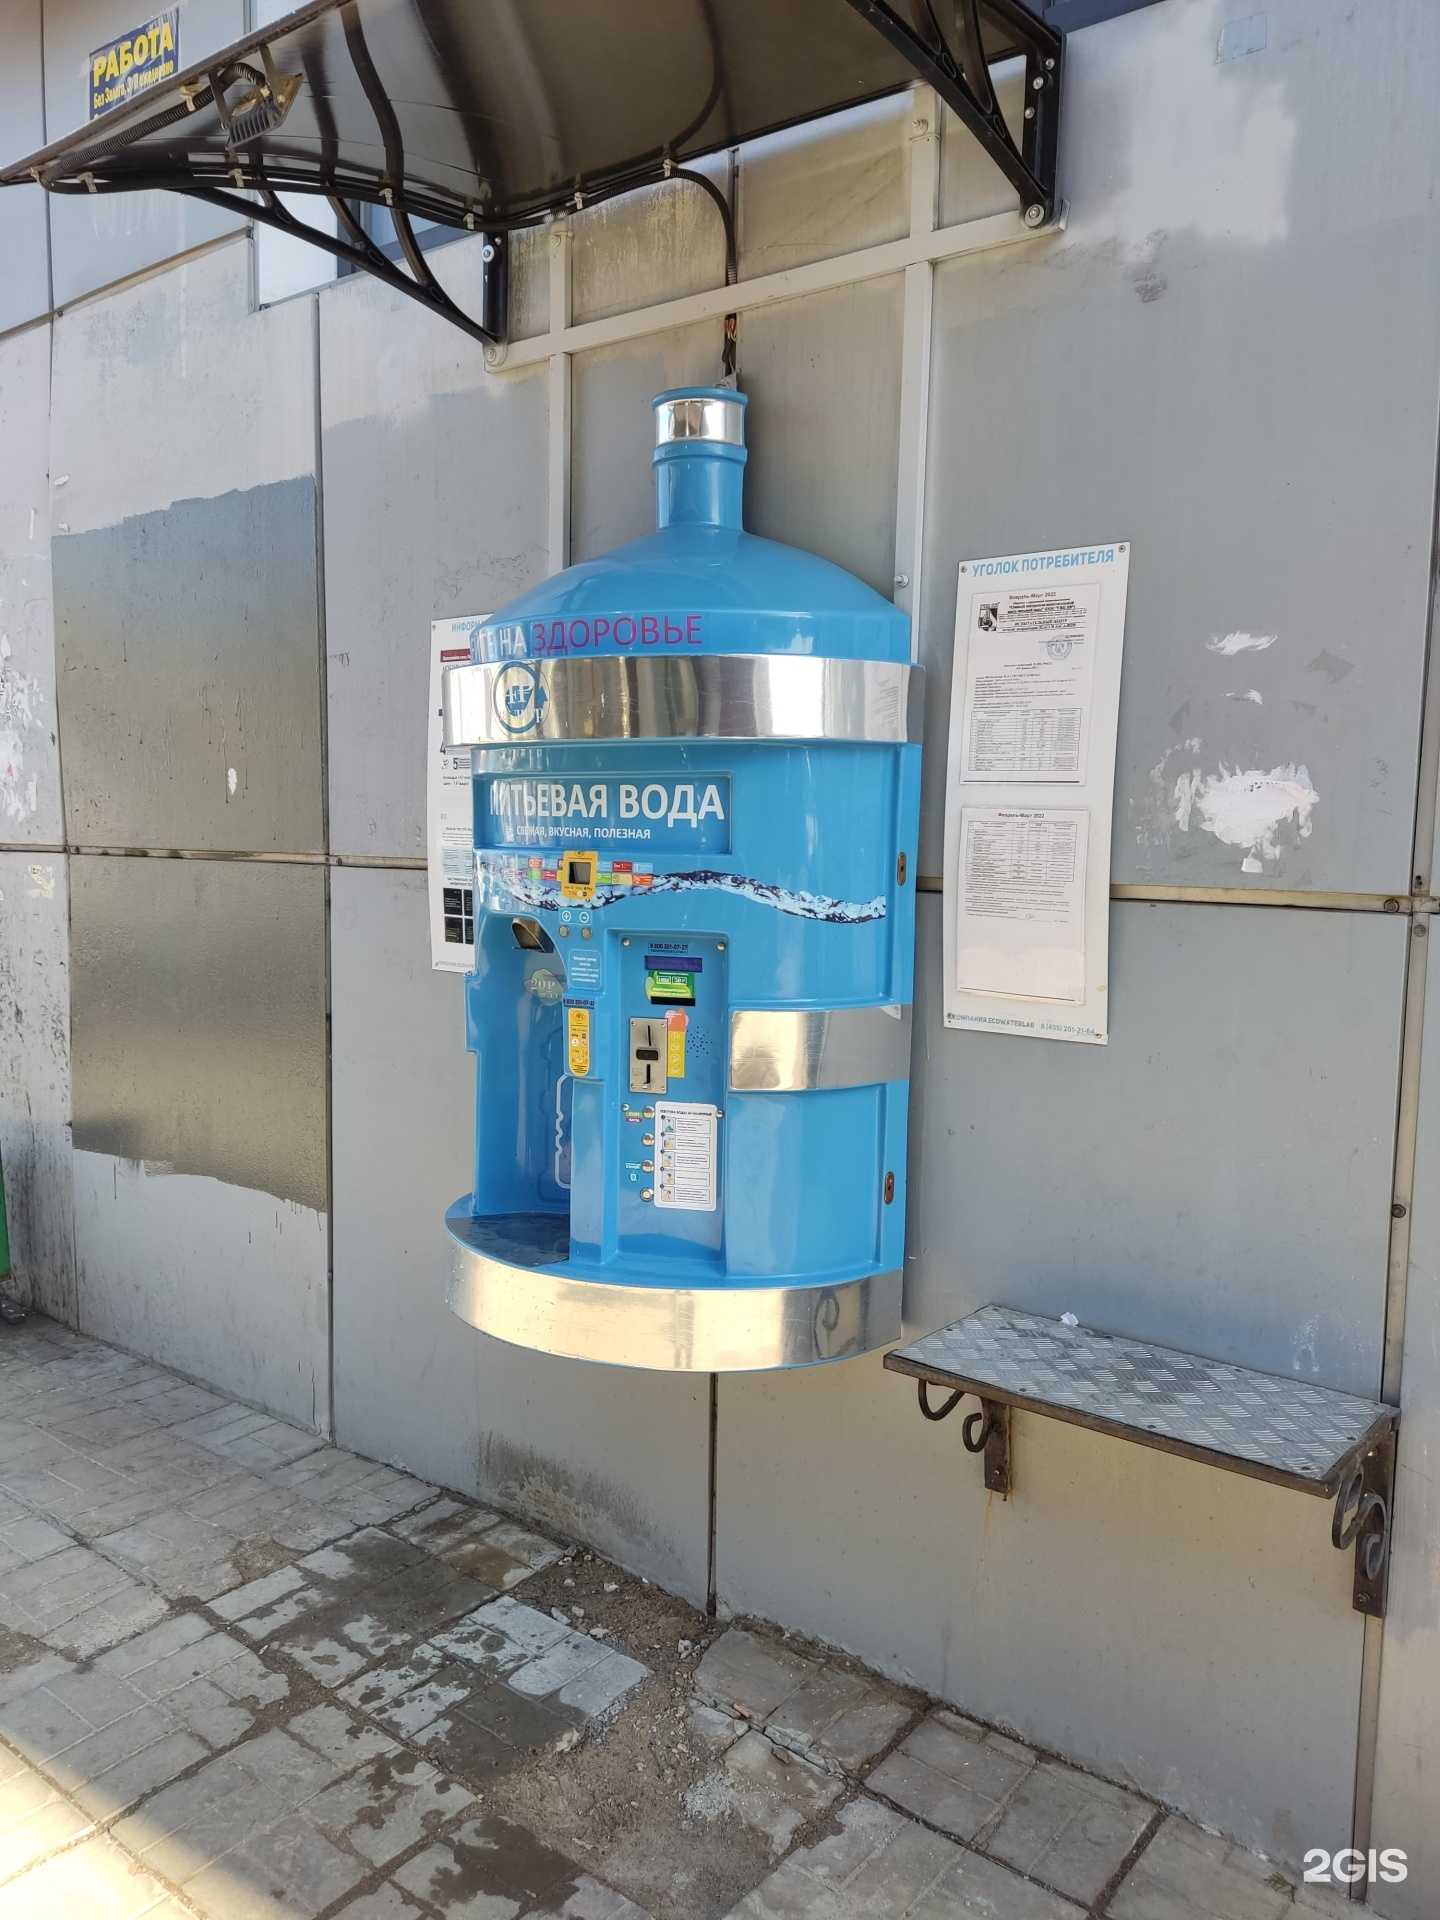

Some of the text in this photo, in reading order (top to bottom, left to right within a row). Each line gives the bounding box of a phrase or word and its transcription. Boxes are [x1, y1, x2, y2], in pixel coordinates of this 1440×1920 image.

[93, 22, 174, 88] РАБОТА
[972, 549, 1114, 577] УГОЛОК ПОТРЕБИТЕЛЯ
[500, 625, 528, 657] НА
[532, 615, 703, 656] ЗДОРОВЬЕ
[490, 783, 725, 828] ПИТЬЕВАЯ ВОДА
[549, 826, 592, 840] ВКУСНАЯ,
[594, 828, 651, 840] ПОЛЕЗНАЯ
